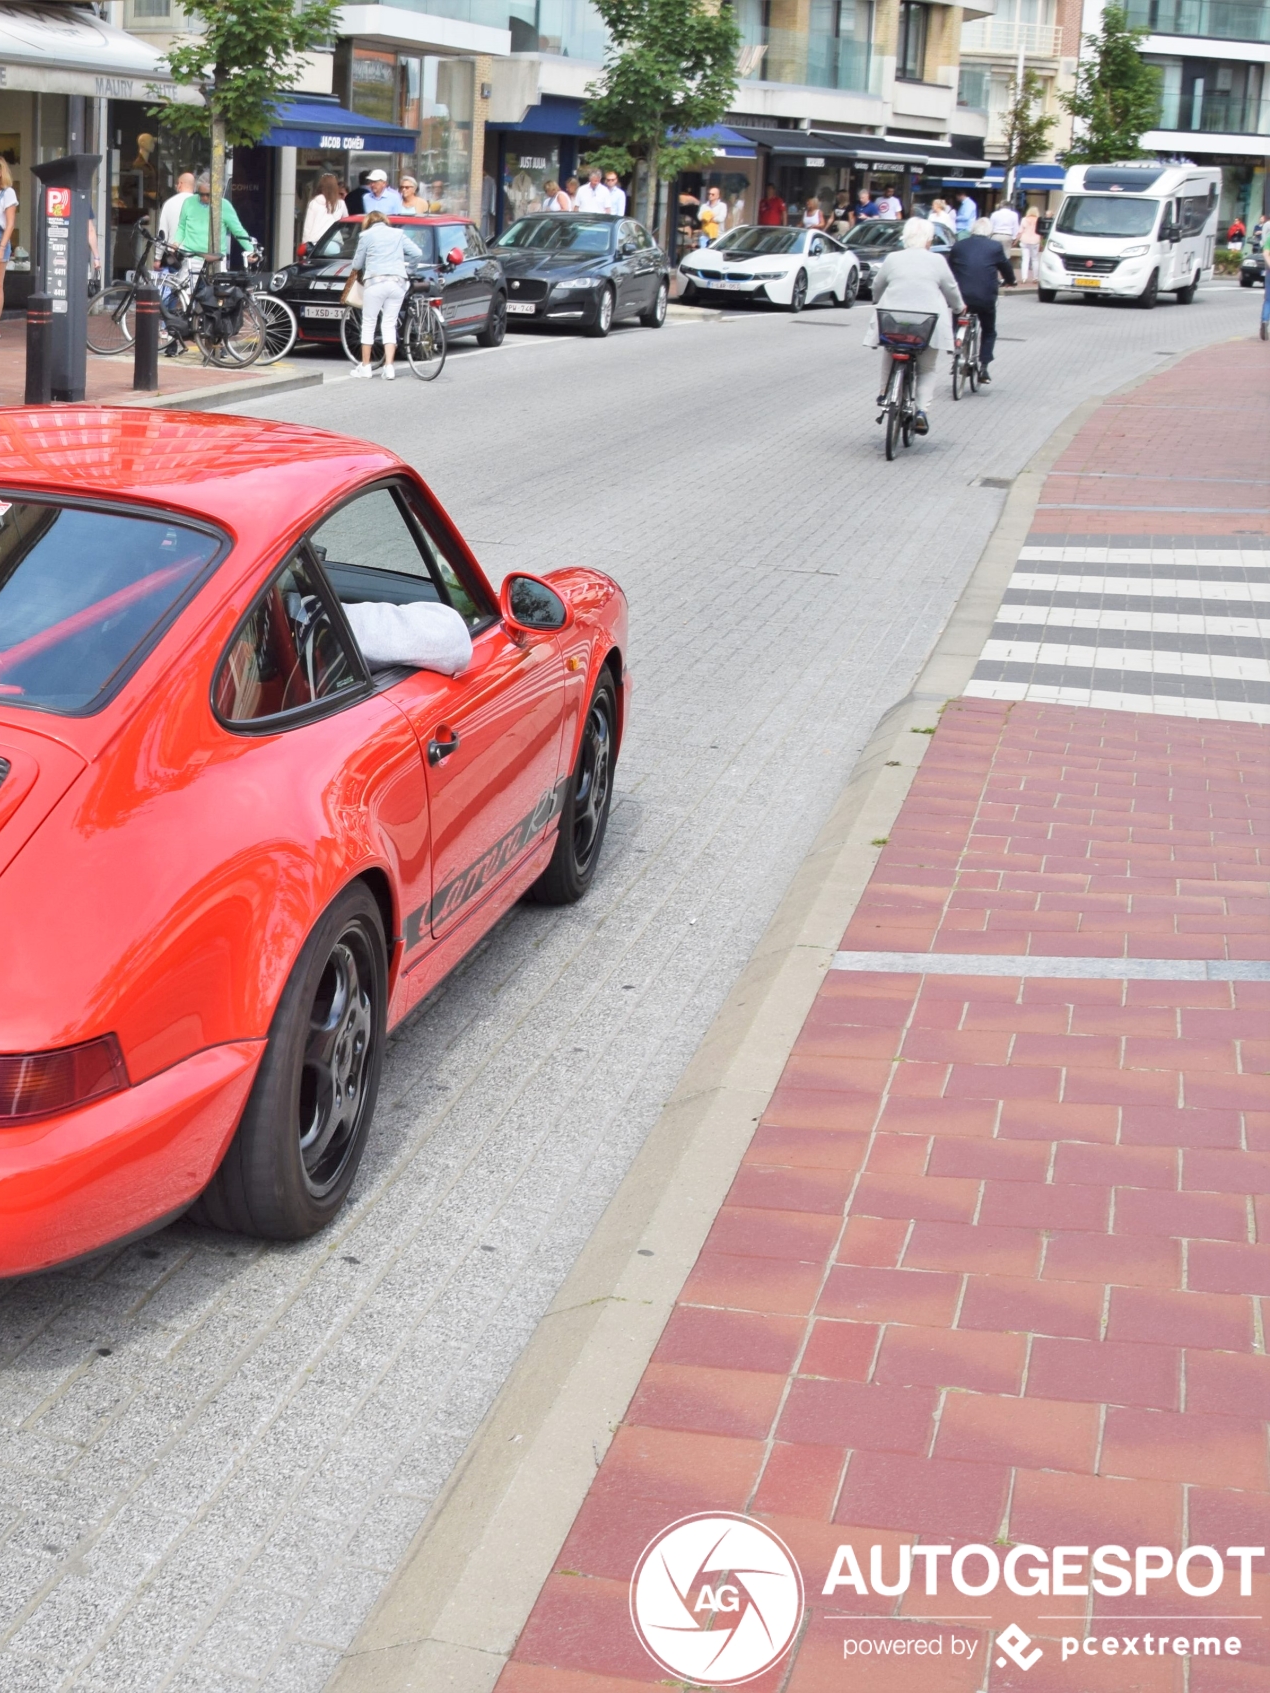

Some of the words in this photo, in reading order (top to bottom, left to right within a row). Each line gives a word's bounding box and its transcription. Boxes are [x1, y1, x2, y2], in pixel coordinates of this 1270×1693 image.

[95, 77, 134, 98] MAURY
[319, 136, 341, 148] JACOB
[520, 156, 532, 168] JUST
[48, 191, 62, 213] P
[418, 825, 523, 937] Carrera
[523, 773, 566, 844] RS
